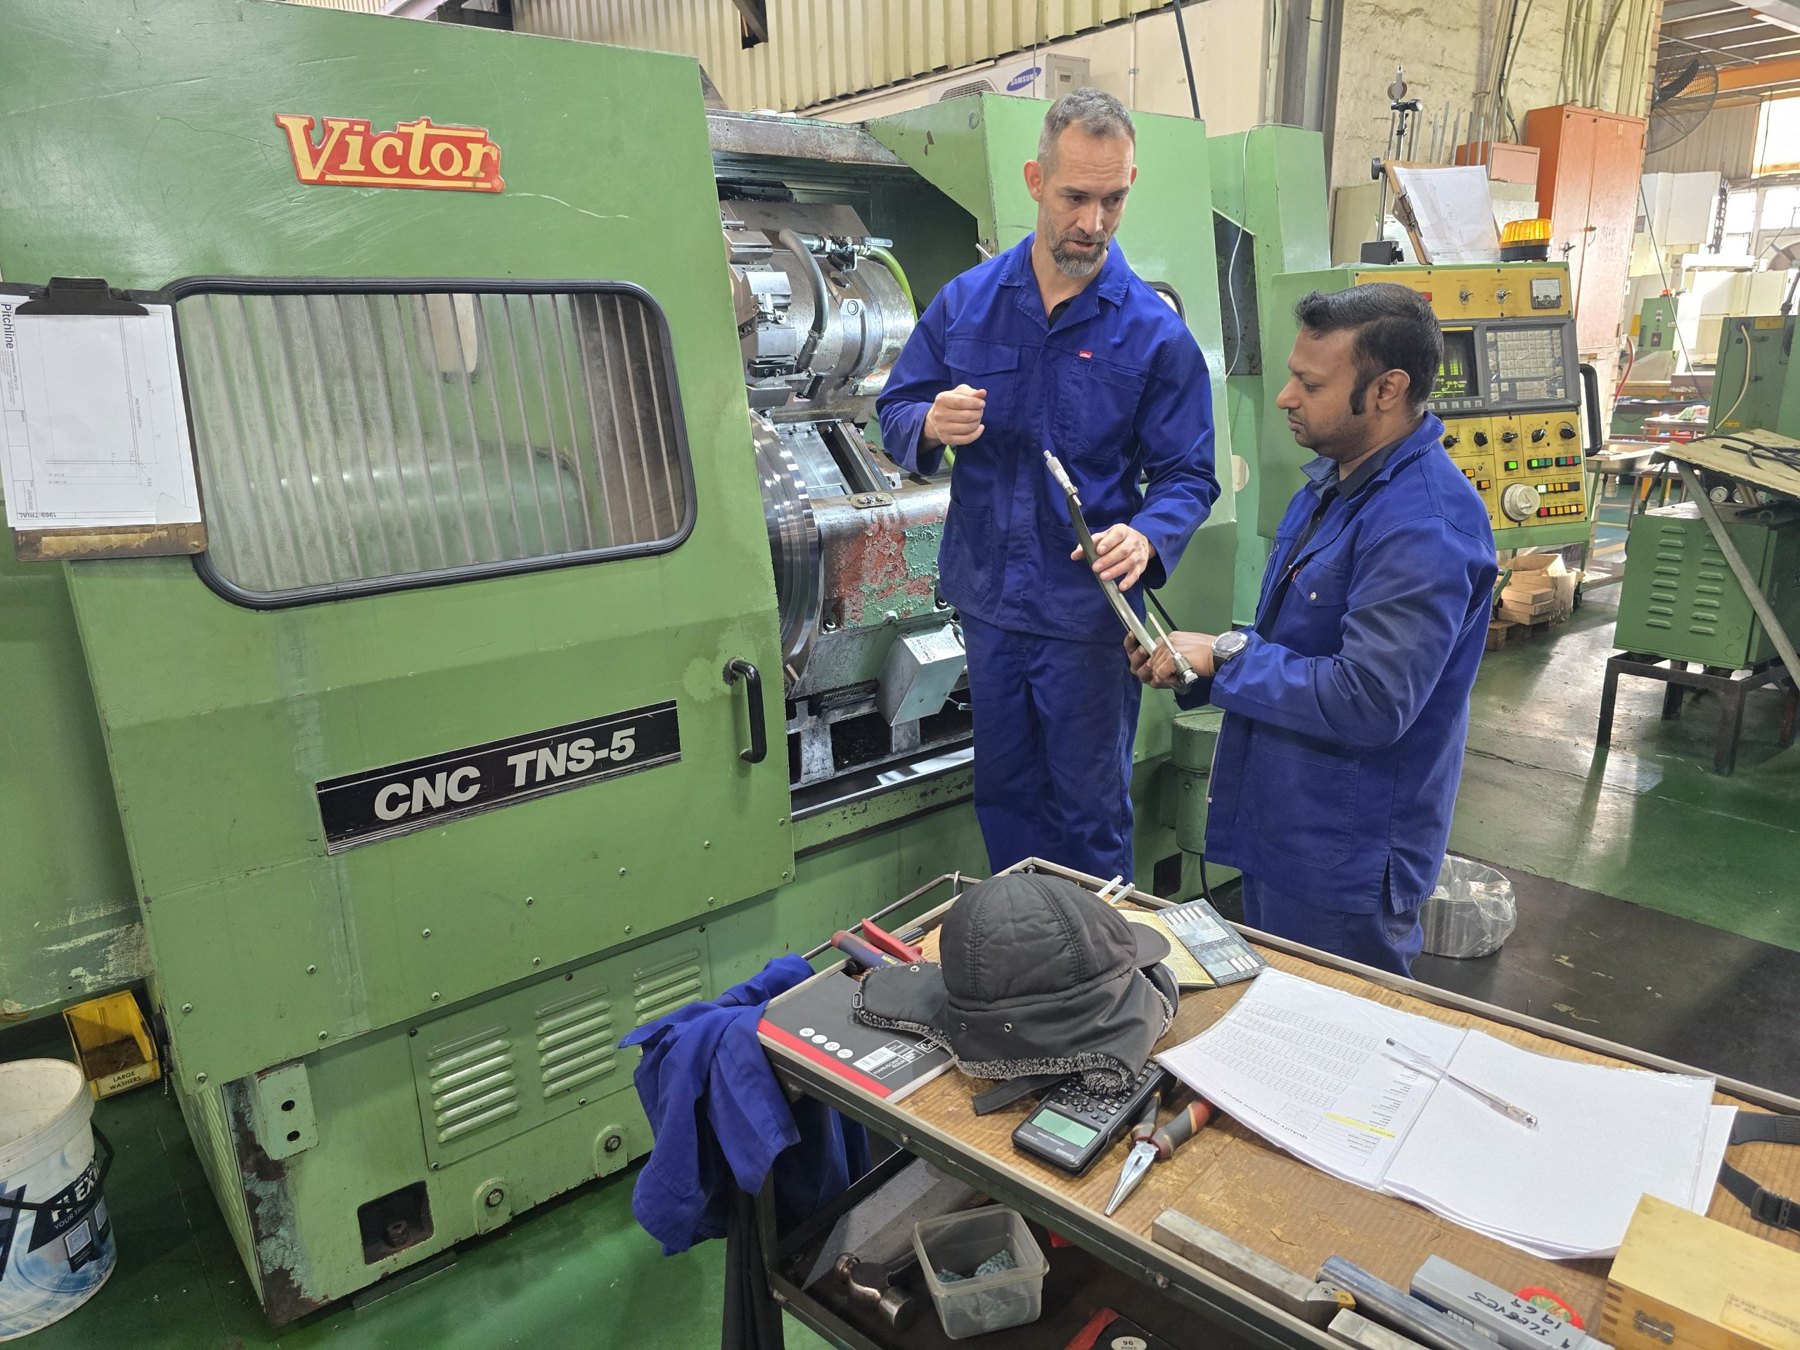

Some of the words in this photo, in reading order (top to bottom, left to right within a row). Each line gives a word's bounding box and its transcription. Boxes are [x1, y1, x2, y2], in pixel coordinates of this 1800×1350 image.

[279, 116, 498, 181] Victor
[1, 303, 14, 349] Pitchline
[374, 766, 481, 821] CNC
[506, 728, 636, 788] TNS-5
[110, 1076, 142, 1090] WASHERS
[113, 1071, 135, 1082] LARGE
[54, 1213, 74, 1230] YOUR
[1467, 1291, 1550, 1336] SLEEVES
[1511, 1298, 1562, 1330] 1969
